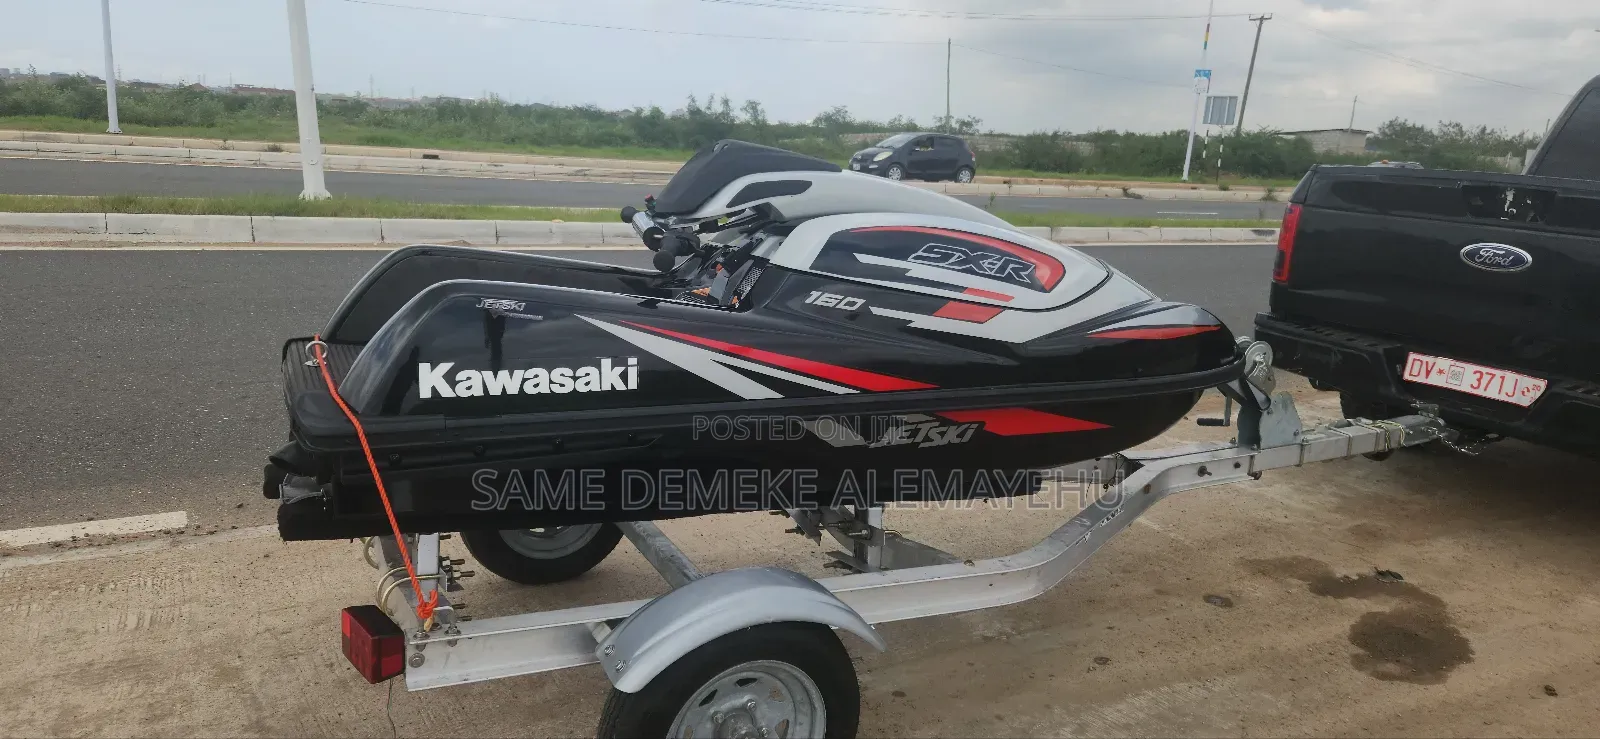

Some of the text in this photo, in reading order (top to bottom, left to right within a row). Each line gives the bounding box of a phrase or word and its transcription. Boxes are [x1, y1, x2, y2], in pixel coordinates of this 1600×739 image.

[1475, 248, 1513, 266] Ford
[804, 291, 866, 311] 160
[418, 357, 640, 399] Kawasaki
[1408, 358, 1518, 397] DV 371J
